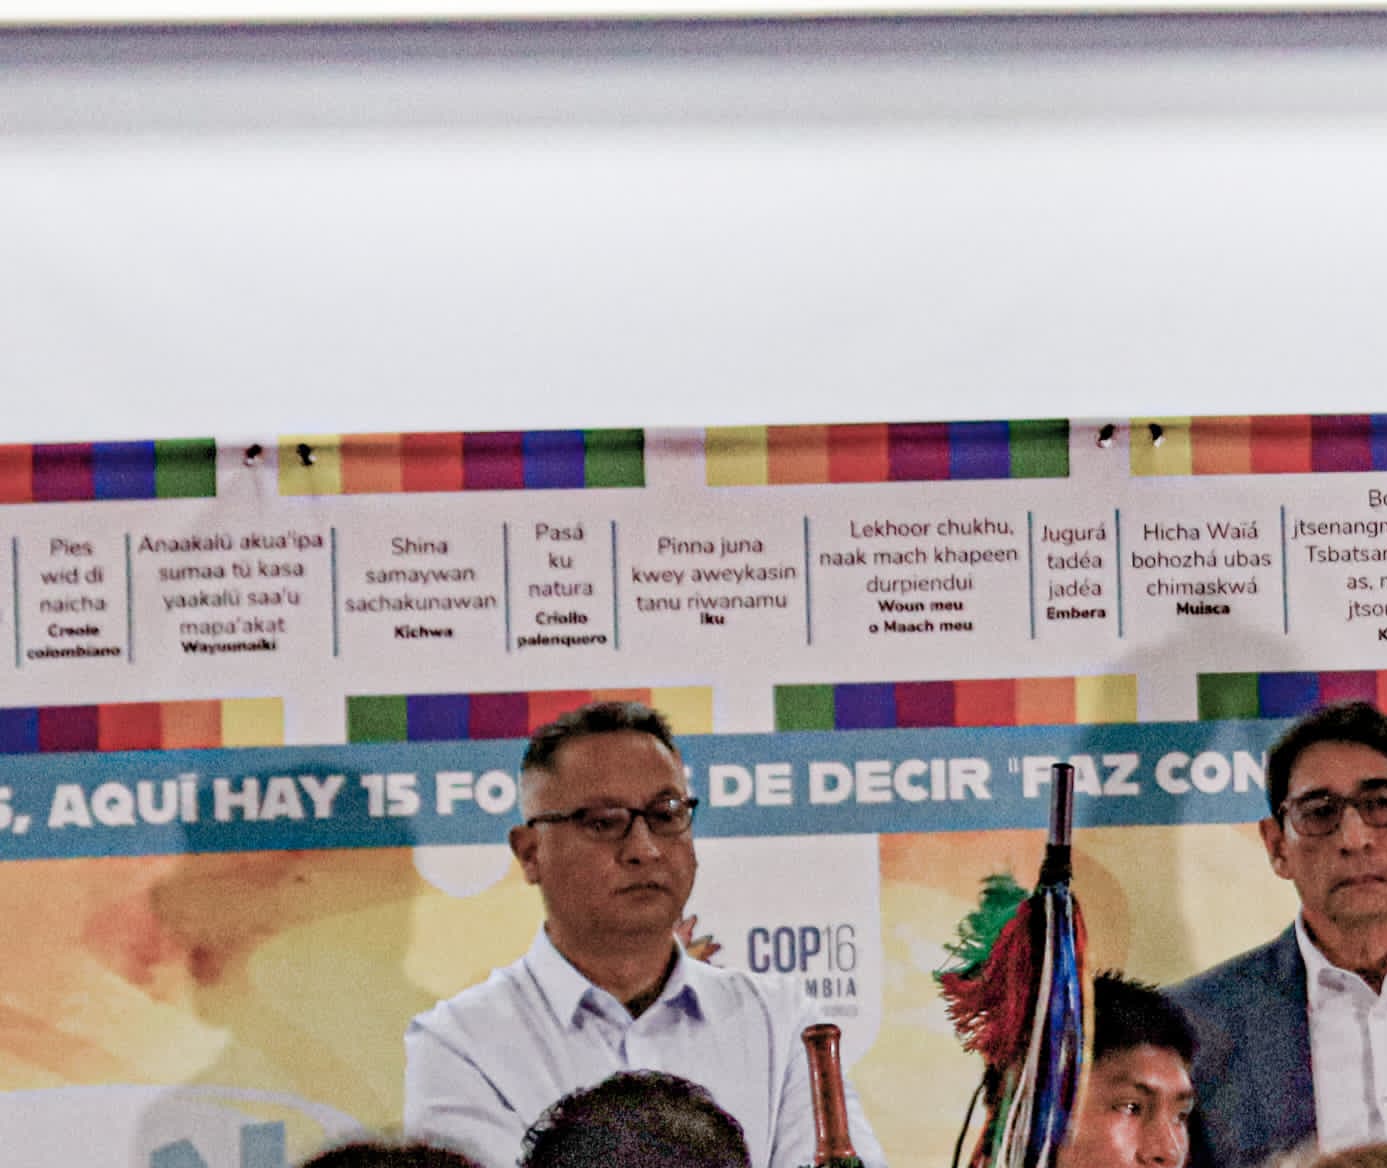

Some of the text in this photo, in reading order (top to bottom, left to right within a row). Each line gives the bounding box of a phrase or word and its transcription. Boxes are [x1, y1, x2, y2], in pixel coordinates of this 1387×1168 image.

[536, 523, 584, 541] Pasá
[850, 520, 931, 538] Lekhoor
[1042, 523, 1106, 546] Jugurá
[1144, 523, 1200, 541] Hicha
[50, 538, 94, 557] Pies
[392, 537, 448, 555] Shina
[658, 536, 763, 557] Pinna juna
[549, 552, 573, 568] ku
[820, 546, 1018, 566] naak mach khapeen
[1048, 551, 1102, 570] tadéa
[1132, 550, 1271, 568] bohozhá ubas
[40, 566, 104, 584] wid di
[159, 566, 226, 581] sumaa
[258, 561, 304, 576] kasa
[366, 568, 476, 584] samaywan
[632, 564, 796, 584] kwey aweykasin
[528, 581, 594, 597] natura
[866, 574, 973, 595] durpiendui
[1049, 578, 1102, 601] jadéa
[1146, 576, 1258, 596] chimaskwá
[1346, 576, 1374, 591] as,
[345, 594, 496, 612] sachakunawan
[636, 594, 787, 612] tanu riwanamu
[877, 599, 965, 613] Woun meu
[1175, 600, 1231, 616] Muisca
[699, 611, 725, 625] Iku
[1046, 606, 1107, 621] Embera
[394, 624, 454, 640] Kichwa
[868, 619, 974, 635] o Maach meu
[181, 638, 277, 655] Wayuunaiki
[517, 633, 607, 648] palenquero
[27, 645, 121, 660] colombiano
[48, 773, 199, 828] AQUÍ
[213, 774, 345, 823] HAY
[360, 773, 420, 819] 15
[709, 762, 794, 807] DE
[809, 757, 992, 804] DECIR
[1155, 751, 1268, 794] CON
[748, 923, 857, 974] COP16
[805, 977, 856, 998] MBIA
